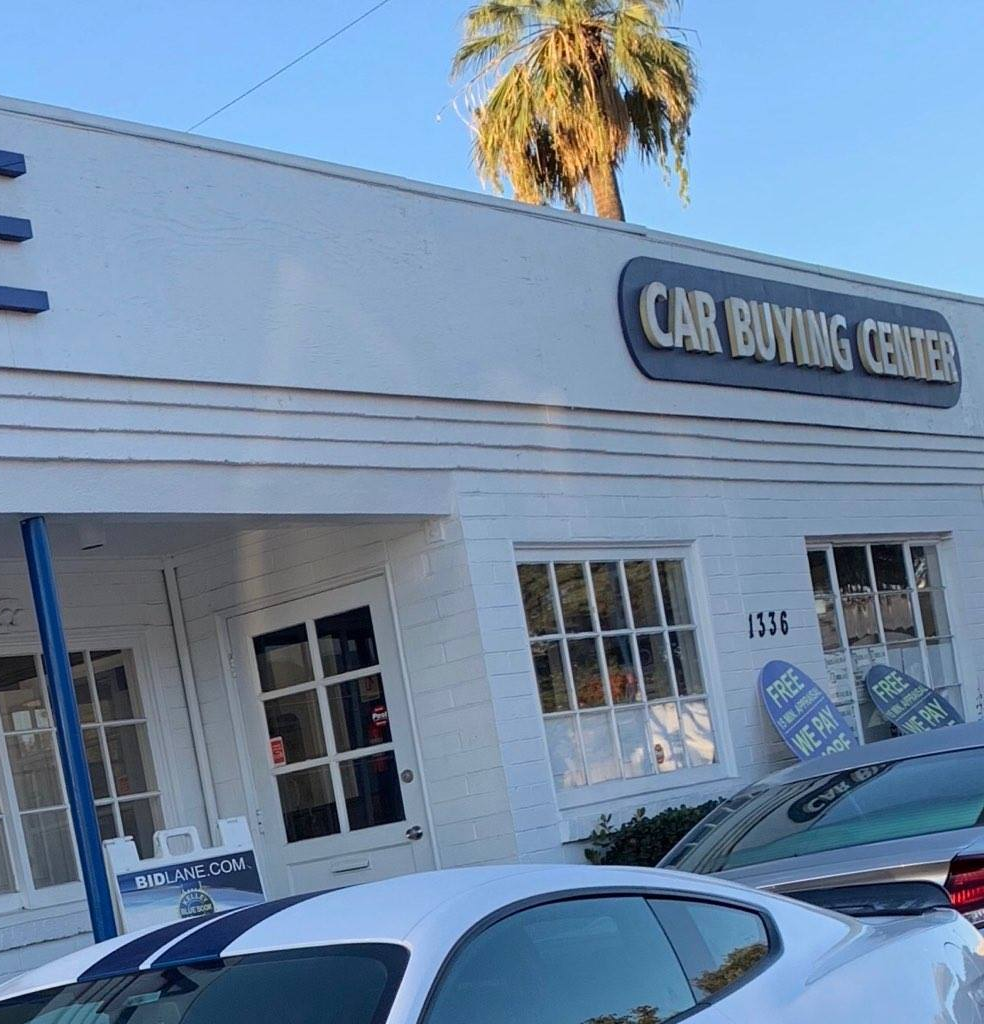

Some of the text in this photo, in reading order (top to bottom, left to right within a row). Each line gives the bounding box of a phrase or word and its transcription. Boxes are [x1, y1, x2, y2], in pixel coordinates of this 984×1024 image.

[639, 281, 959, 384] CAR BUYING CENTER
[748, 611, 789, 639] 1336
[766, 667, 805, 709] FREE
[871, 670, 910, 703] FREE
[918, 697, 948, 727] PAY
[791, 704, 839, 757] WE PAY
[135, 857, 246, 889] BIDLANE.COM
